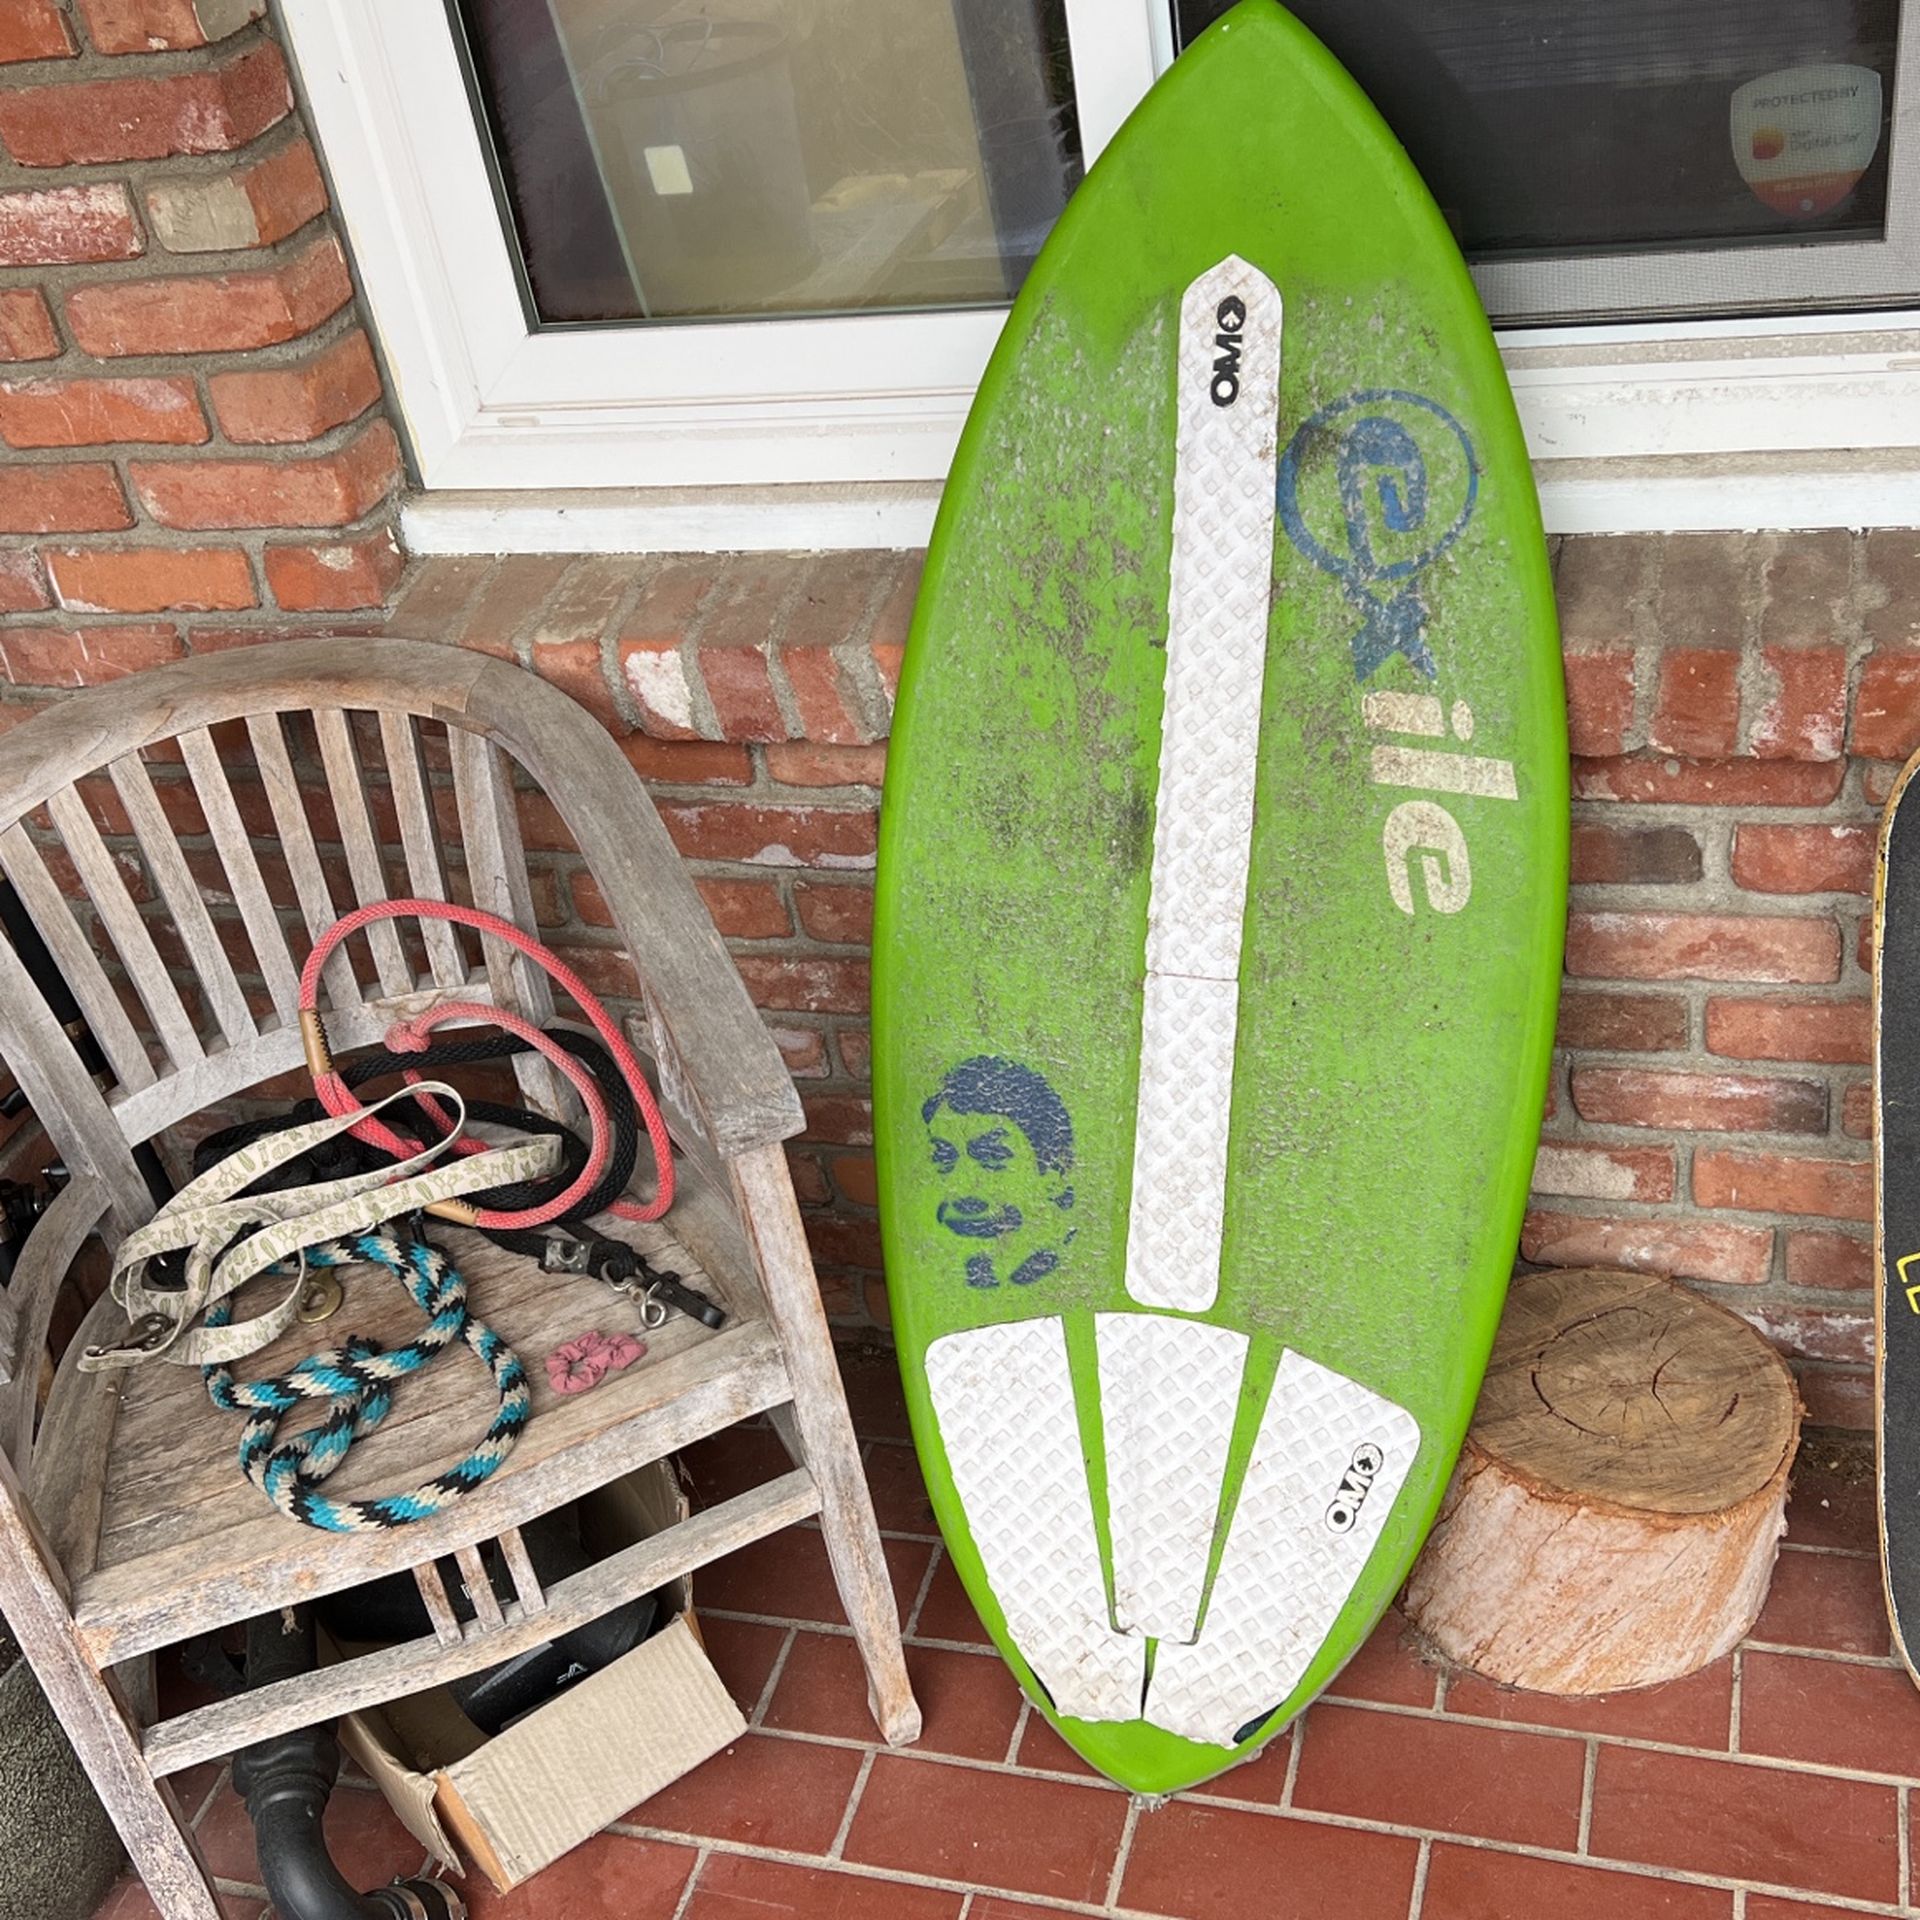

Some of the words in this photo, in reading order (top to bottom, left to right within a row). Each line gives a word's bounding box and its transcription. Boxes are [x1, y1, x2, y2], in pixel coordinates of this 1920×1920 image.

[1753, 88, 1838, 109] PROTECTED
[1840, 85, 1859, 99] BY
[1337, 416, 1518, 915] exile
